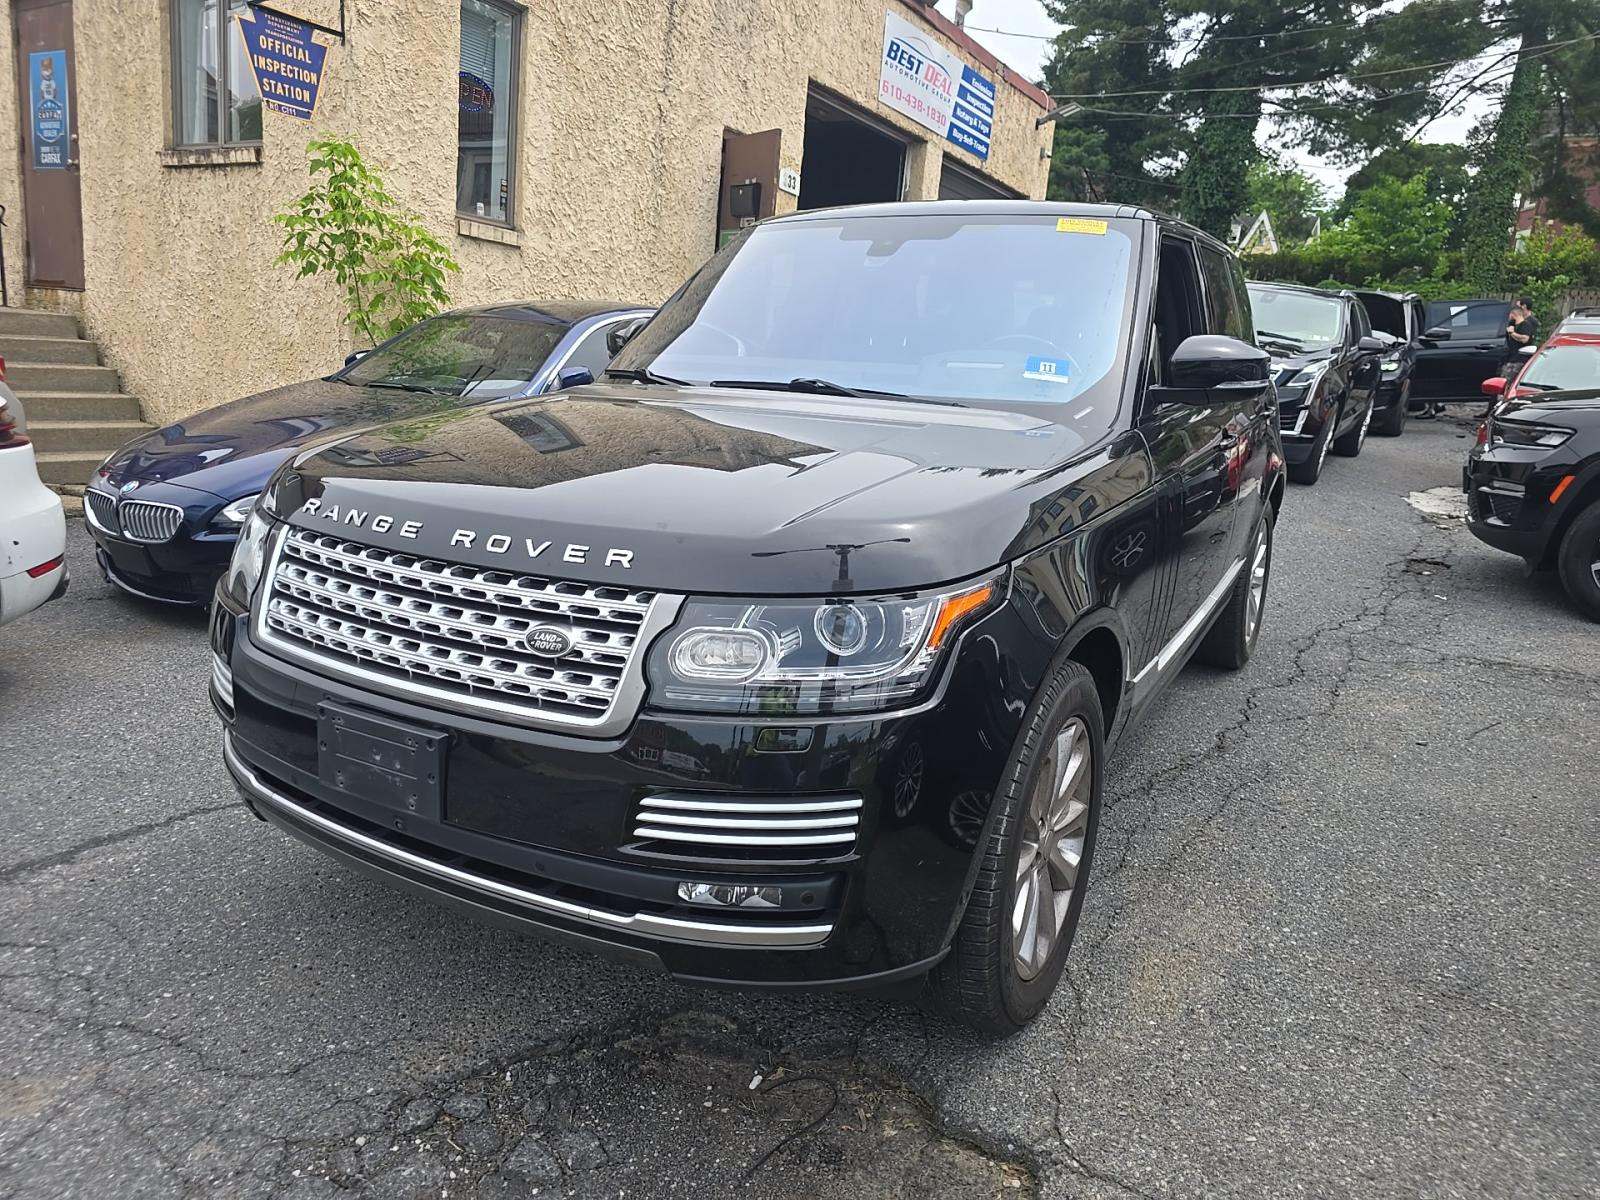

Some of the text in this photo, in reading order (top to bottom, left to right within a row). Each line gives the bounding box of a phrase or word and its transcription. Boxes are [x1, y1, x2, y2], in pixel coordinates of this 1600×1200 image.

[260, 35, 311, 63] OFFICIAL
[254, 54, 317, 85] INSPECTION
[884, 60, 951, 104] AUTOMOTIVE GROUP
[887, 40, 952, 97] BEST DEAL
[263, 78, 311, 104] STATION
[459, 82, 492, 108] PEN
[882, 79, 947, 127] 610-438-1830
[966, 92, 991, 114] Inspection
[956, 106, 972, 126] Notary
[302, 497, 635, 569] RANGE ROVER
[534, 632, 557, 642] LAND
[534, 640, 562, 651] ROVER
